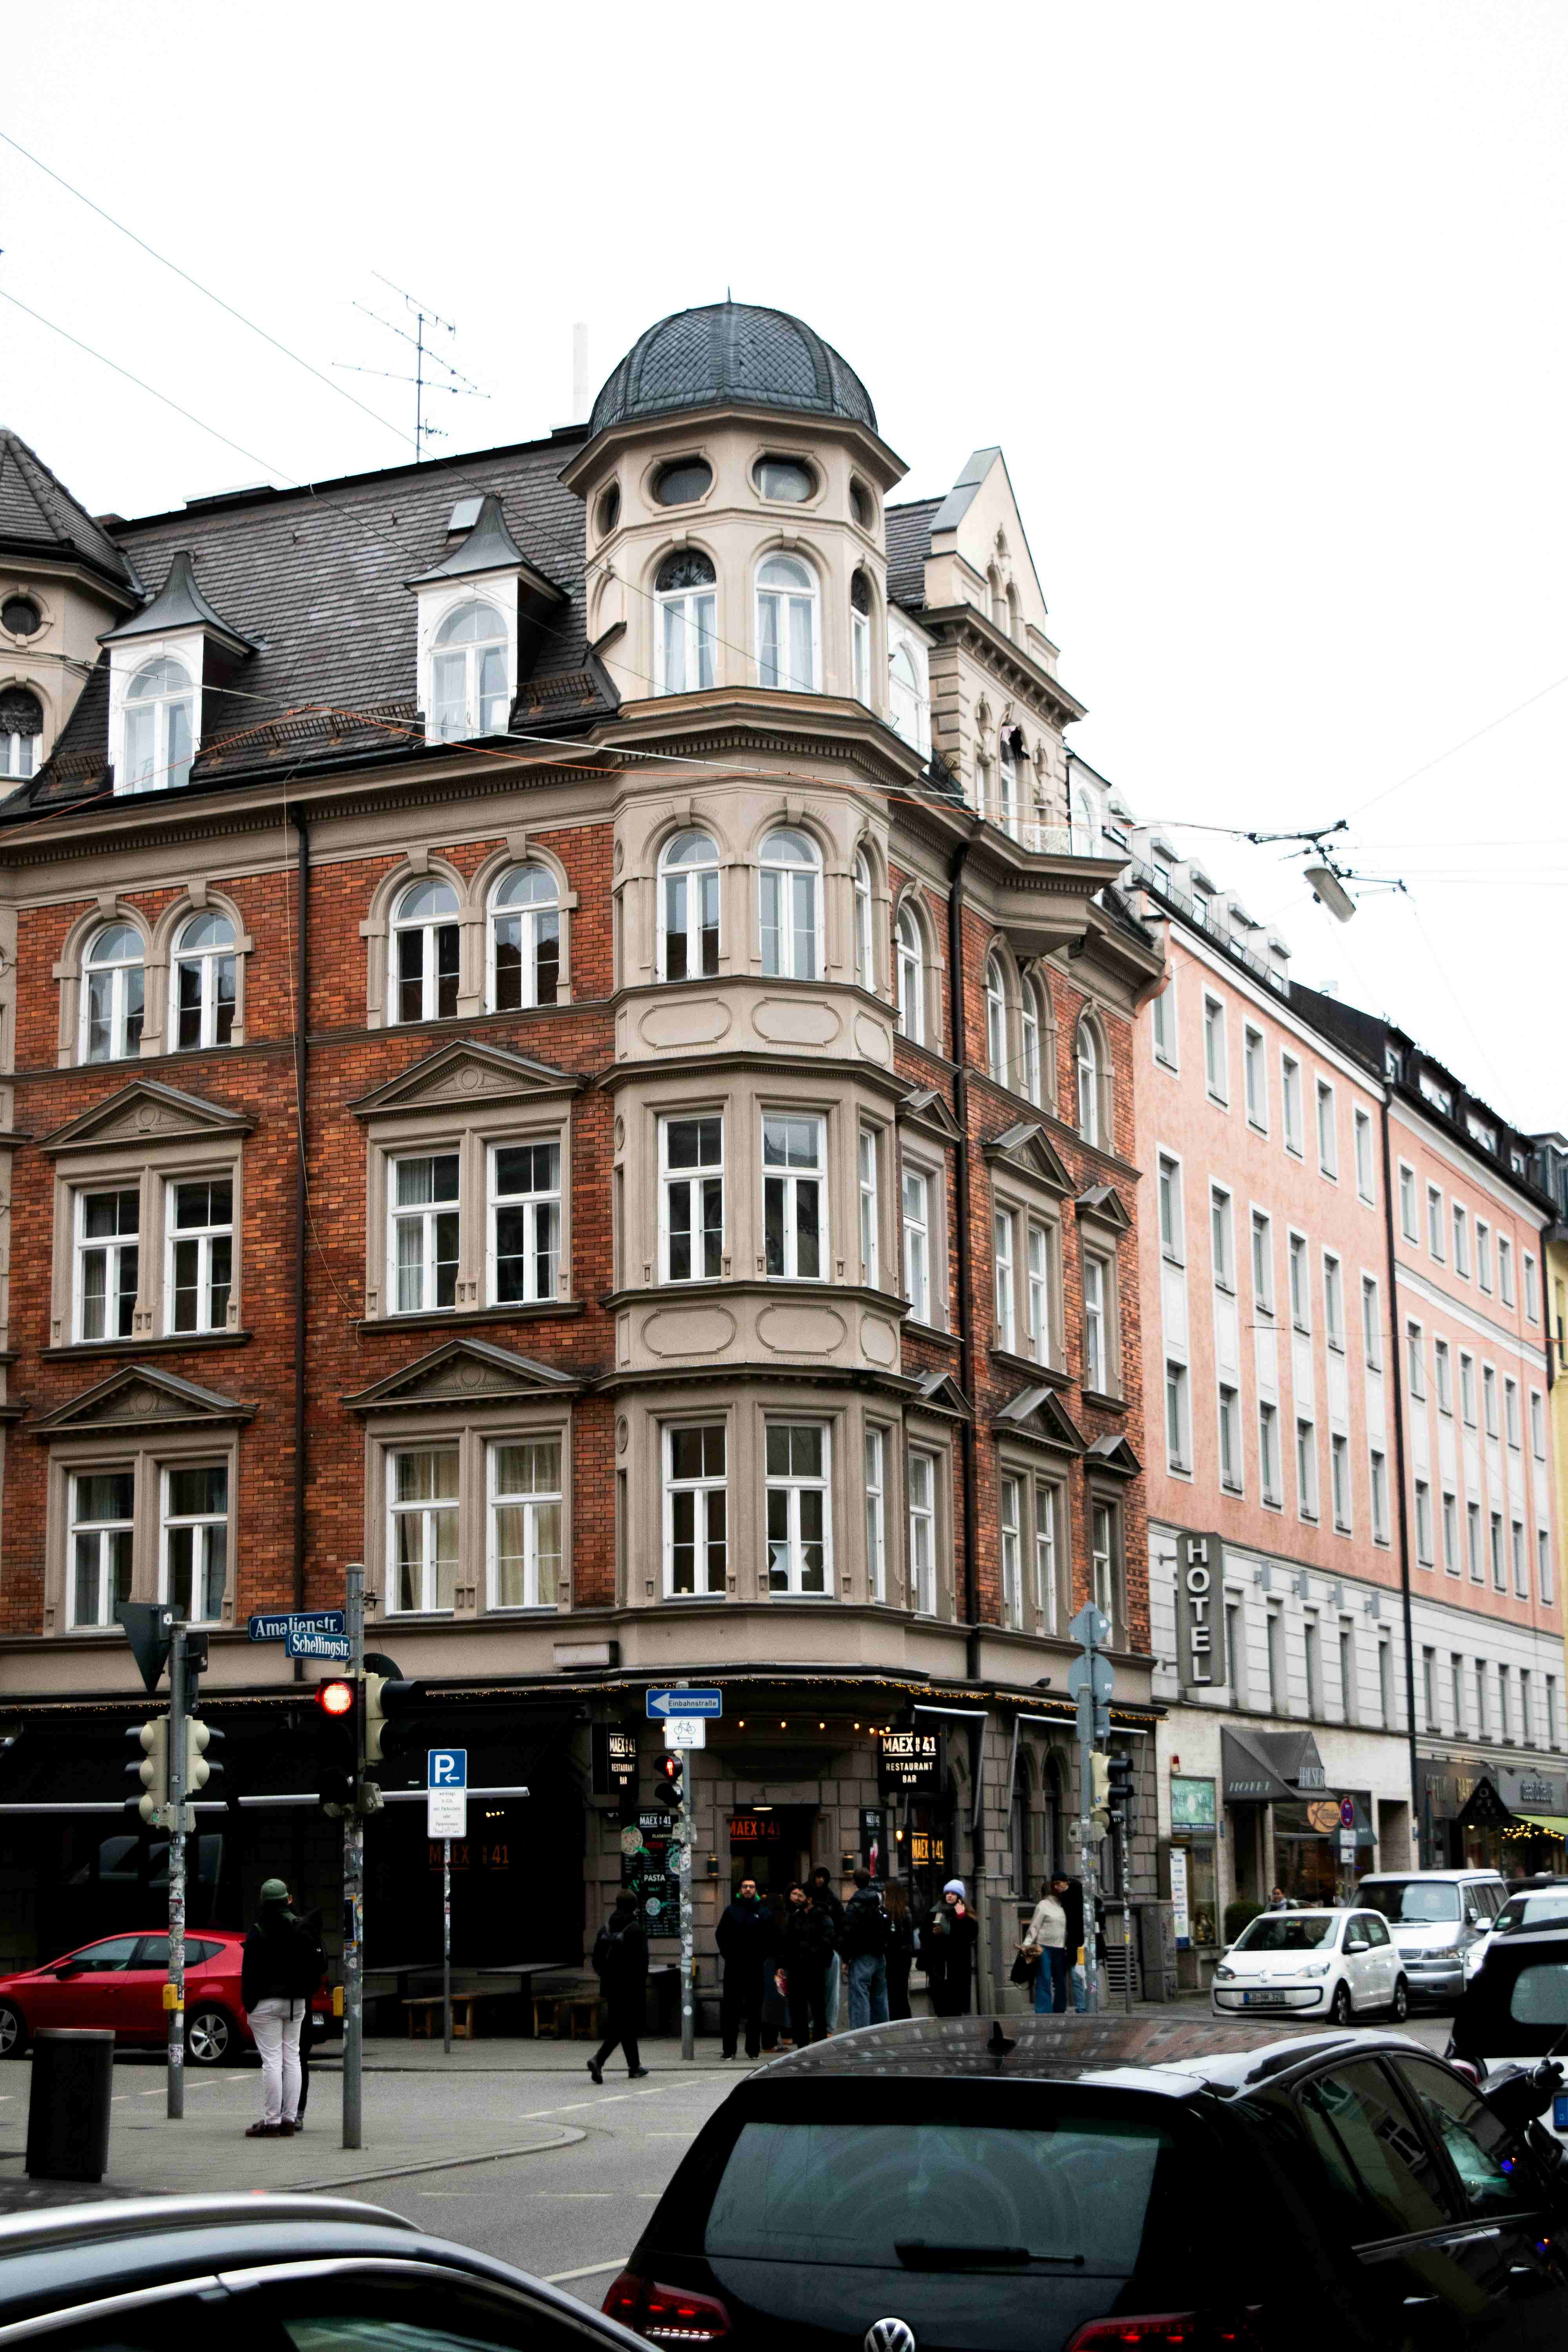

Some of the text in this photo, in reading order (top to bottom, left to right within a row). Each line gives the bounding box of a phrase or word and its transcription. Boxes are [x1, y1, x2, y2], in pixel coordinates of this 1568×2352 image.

[1187, 1539, 1210, 1681] HOTEL
[255, 1617, 338, 1637] Amalienstr.
[293, 1634, 349, 1658] Schellingstr.
[610, 1737, 625, 1752] MAEX
[629, 1739, 636, 1753] 41
[883, 1737, 913, 1752] MAEX
[922, 1737, 936, 1752] 41
[612, 1764, 635, 1772] RESTAURANT
[886, 1762, 933, 1771] RESTAURANT
[902, 1775, 916, 1783] BAR
[640, 1816, 657, 1825] MAEX
[663, 1816, 671, 1824] 41
[429, 1844, 469, 1864] MEX
[492, 1844, 509, 1863] 41
[912, 1839, 928, 1858] MAEX
[936, 1840, 943, 1858] 41
